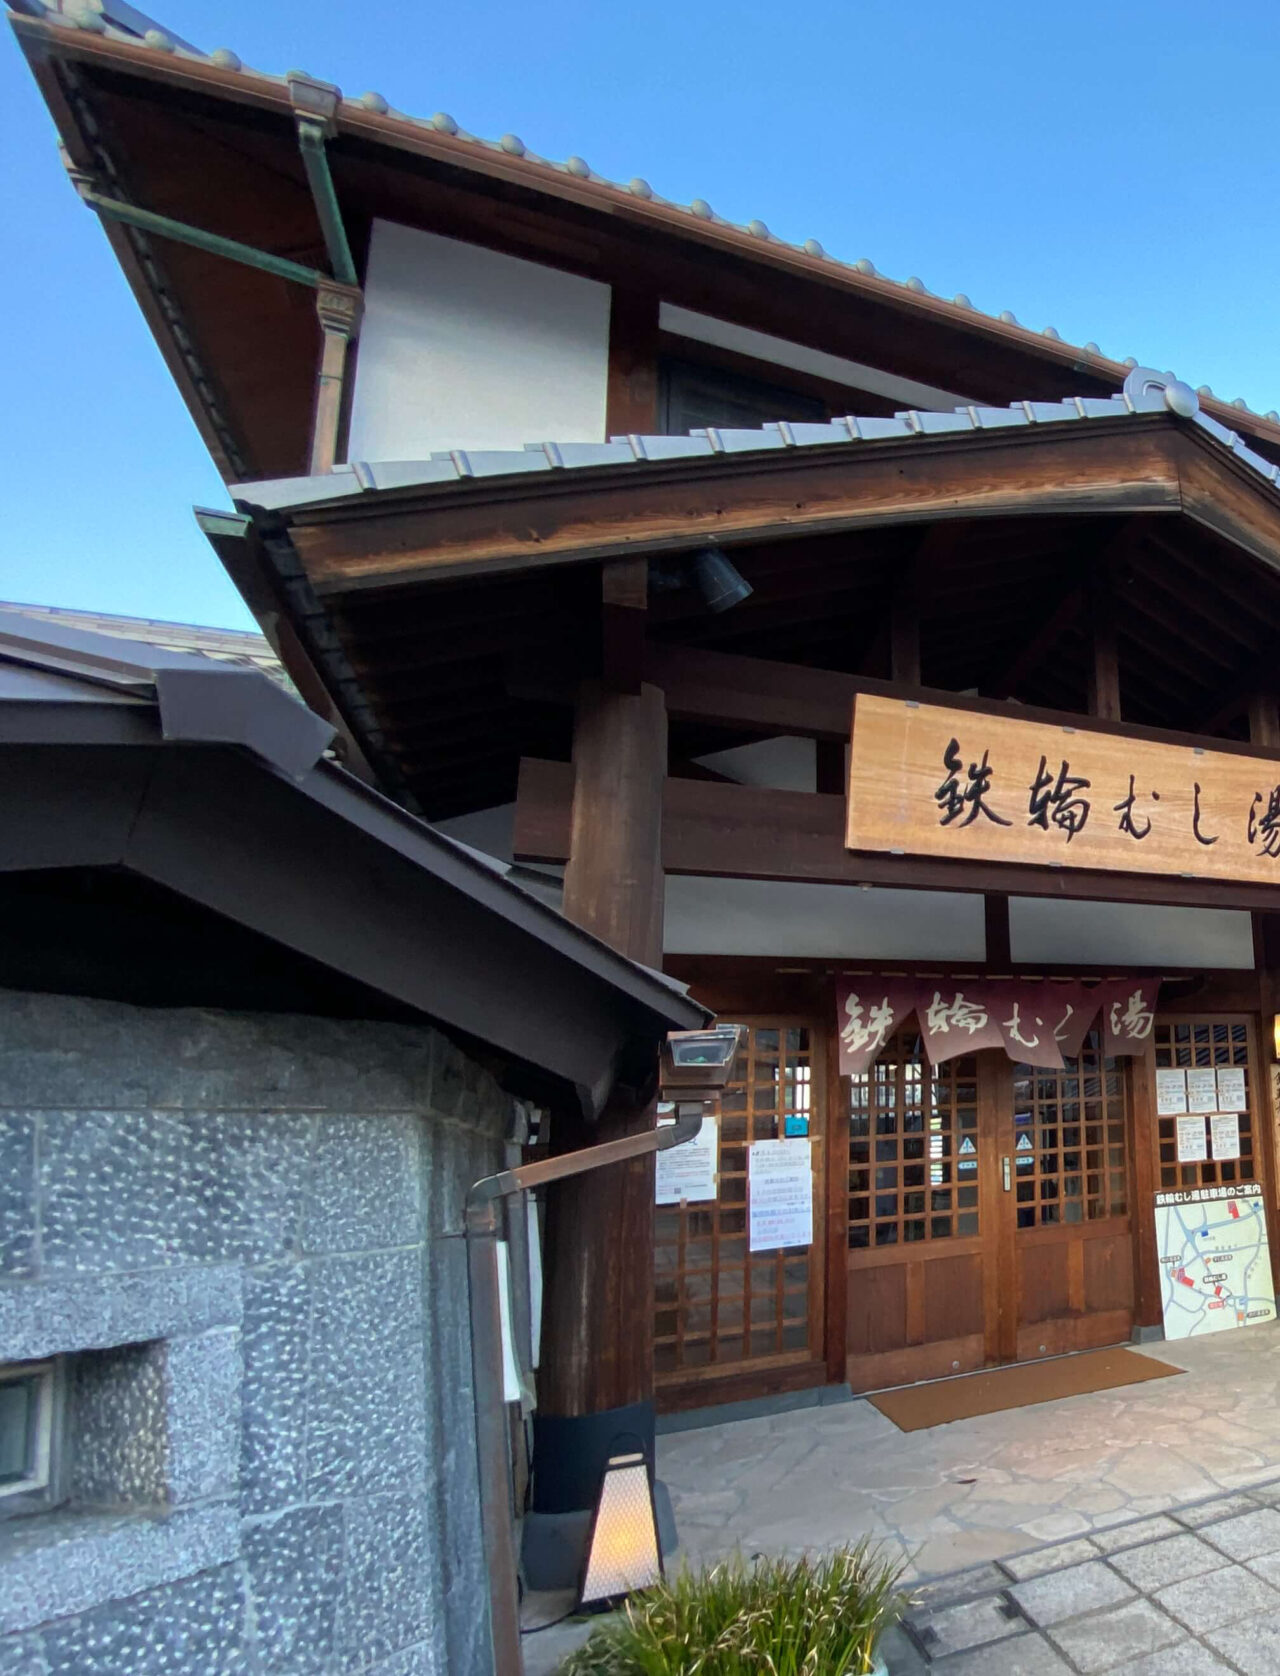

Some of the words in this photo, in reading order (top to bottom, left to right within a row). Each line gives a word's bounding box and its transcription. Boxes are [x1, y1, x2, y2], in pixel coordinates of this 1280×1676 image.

[840, 988, 1155, 1054] 鉄輪むし湯
